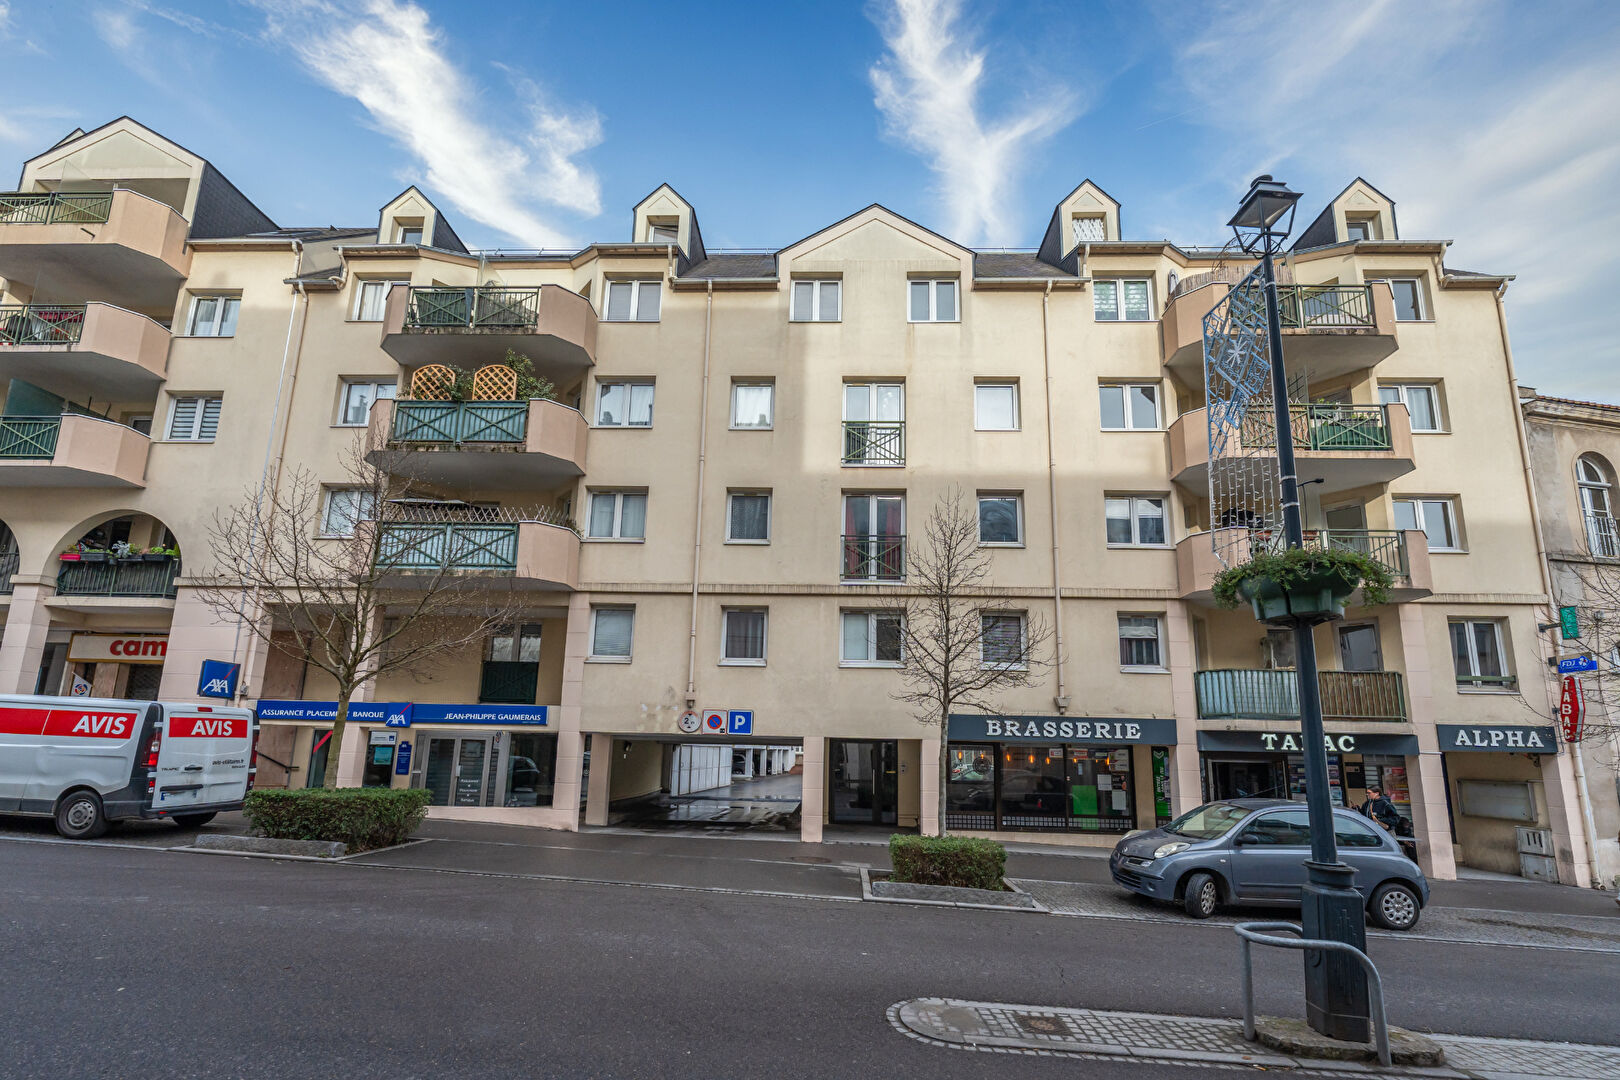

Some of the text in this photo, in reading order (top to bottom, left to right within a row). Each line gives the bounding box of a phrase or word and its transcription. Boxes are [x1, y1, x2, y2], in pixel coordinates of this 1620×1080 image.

[202, 678, 229, 694] AXA
[306, 710, 349, 718] PLACEMT
[1562, 679, 1573, 739] TABAC
[72, 715, 128, 735] AVIS
[191, 720, 233, 736] AVIS
[387, 714, 406, 725] AXA
[735, 715, 746, 729] P
[986, 719, 1142, 740] BRASSERIE
[1261, 733, 1355, 752] TAAC
[1455, 729, 1545, 748] ALPHA
